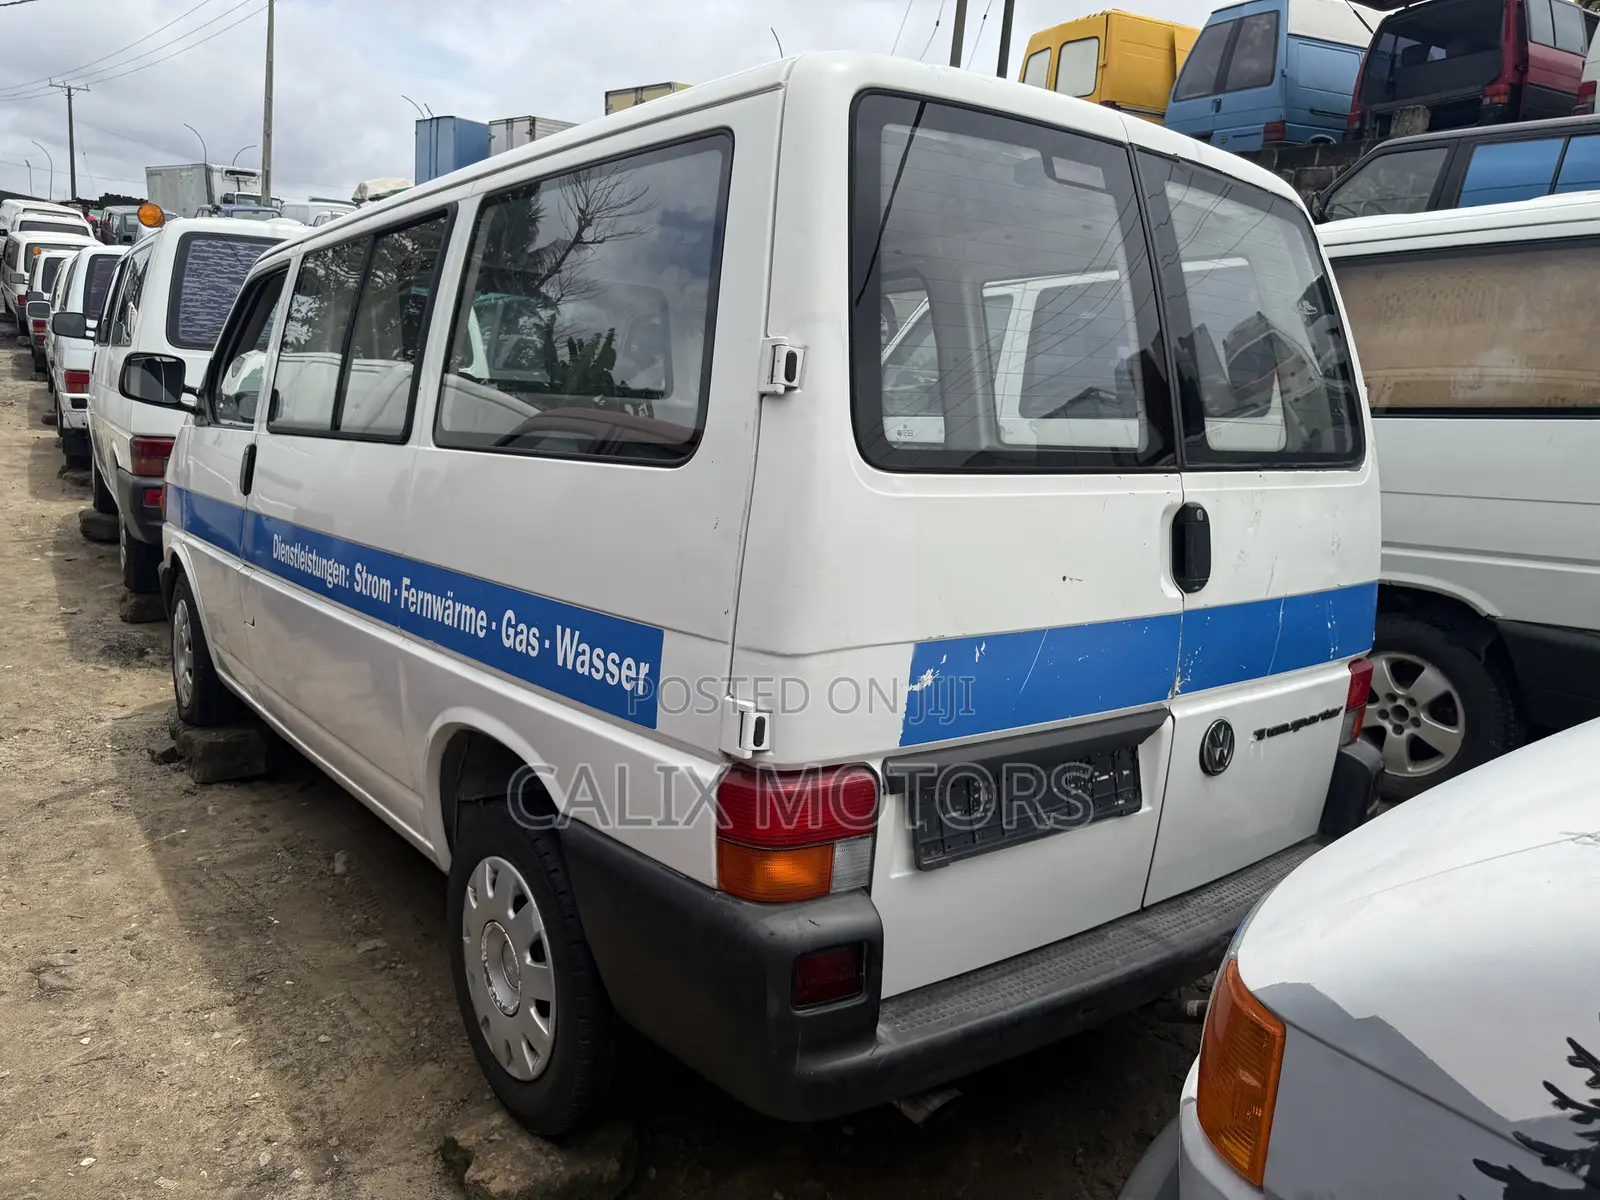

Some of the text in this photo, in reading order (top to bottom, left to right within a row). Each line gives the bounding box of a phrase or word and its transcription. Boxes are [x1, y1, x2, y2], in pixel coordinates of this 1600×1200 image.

[272, 533, 349, 588] Dienstleistungen:
[353, 562, 391, 604] Strom
[401, 576, 487, 638] Fernwärme
[501, 609, 539, 657] Gas
[556, 625, 650, 696] Wasser
